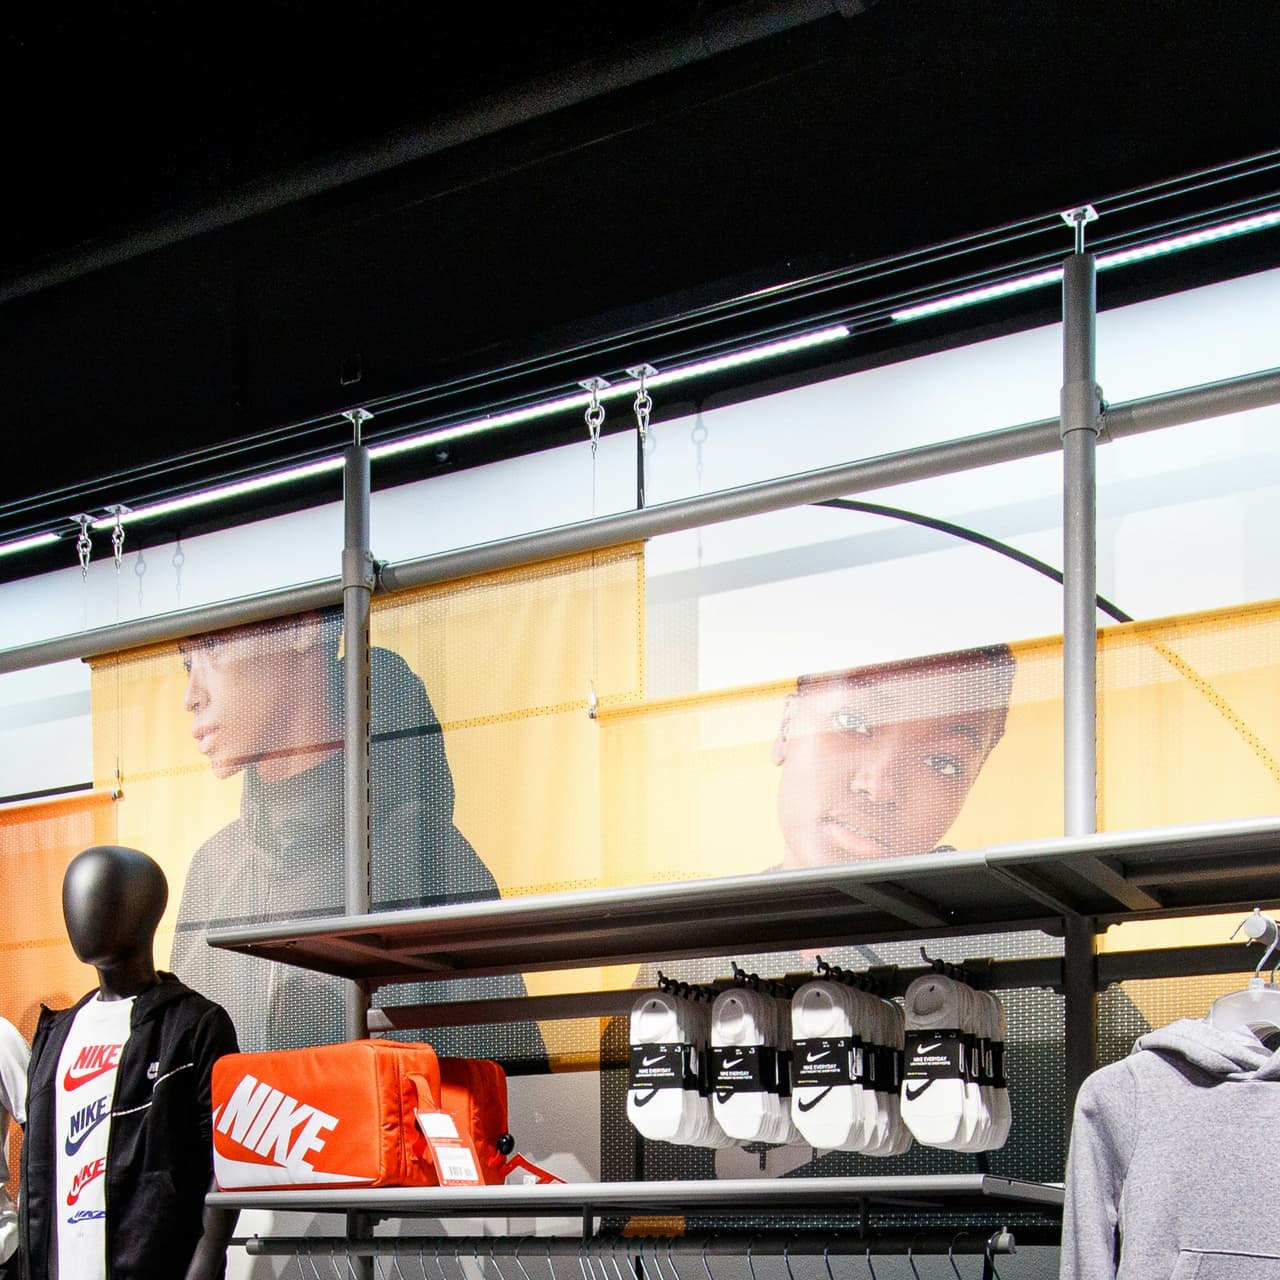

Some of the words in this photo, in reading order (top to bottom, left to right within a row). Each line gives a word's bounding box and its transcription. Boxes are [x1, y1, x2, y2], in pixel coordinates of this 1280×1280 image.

[72, 1044, 122, 1070] NIKE
[70, 1095, 107, 1138] NIKE
[216, 1073, 339, 1173] NIKE
